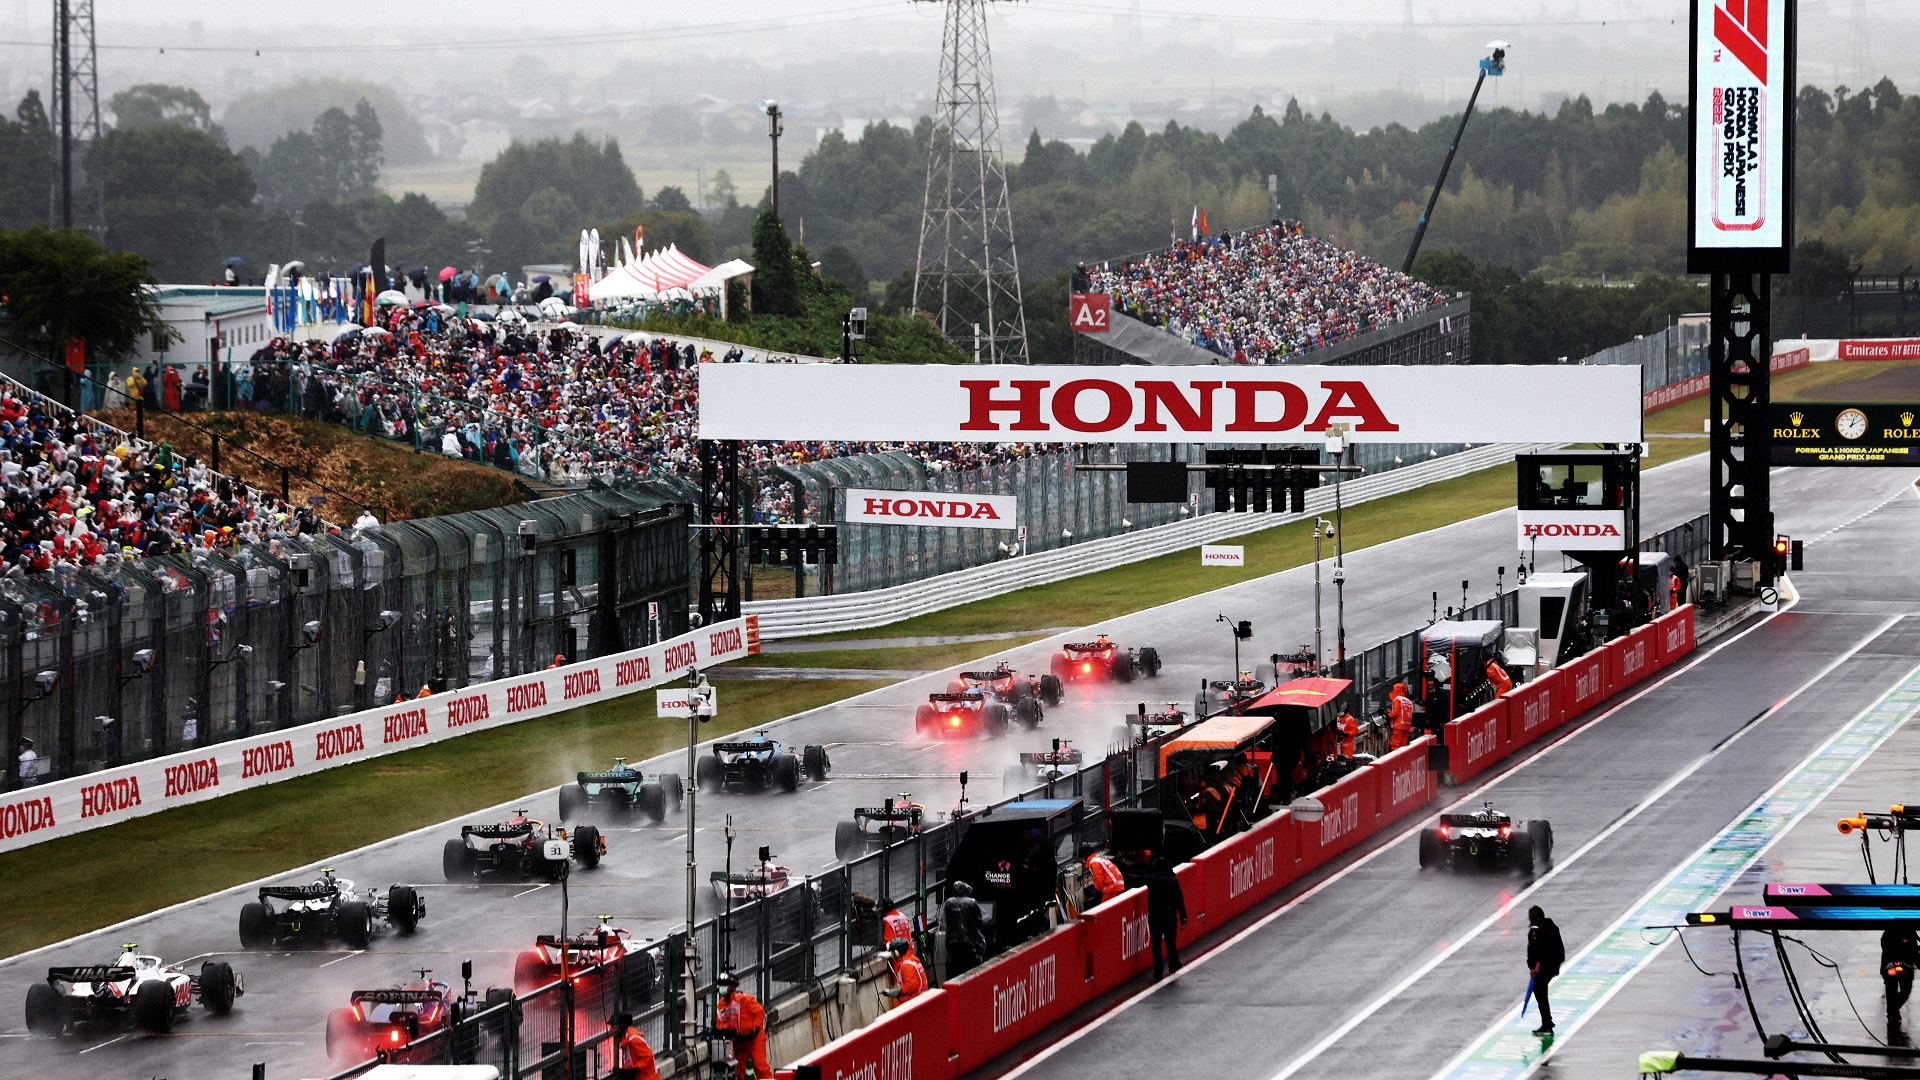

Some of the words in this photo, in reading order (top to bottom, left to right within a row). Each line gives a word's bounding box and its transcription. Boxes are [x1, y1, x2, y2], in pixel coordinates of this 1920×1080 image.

[1712, 87, 1723, 126] 2022
[1724, 87, 1736, 139] GRAND
[1735, 87, 1747, 138] HONDA
[1747, 87, 1759, 161] FORMULA
[1723, 142, 1735, 178] PRIX
[1747, 163, 1758, 171] 1
[1735, 141, 1746, 216] JAPANESE
[1075, 302, 1106, 326] A2
[1846, 344, 1889, 356] Emirates
[1891, 344, 1902, 356] FLY
[959, 379, 1399, 432] HONDA
[1773, 428, 1821, 438] ROLEX
[863, 497, 1000, 520] HONDA
[1523, 523, 1621, 537] HONDA
[664, 641, 697, 673] HONDA
[710, 627, 743, 656] HONDA
[563, 668, 601, 700] HONDA
[615, 656, 651, 687] HONDA
[447, 694, 490, 727] HONDA
[507, 681, 547, 712] HONDA
[315, 723, 365, 761] HONDA
[384, 708, 429, 744] HONDA
[242, 739, 295, 780] HONDA
[164, 757, 220, 798] HONDA
[81, 776, 142, 818] HONDA
[550, 847, 562, 855] 31
[1121, 909, 1150, 961] Emirates
[69, 967, 123, 981] HAAS
[364, 991, 429, 1000] SOFINA
[993, 976, 1027, 1033] Emirates
[1038, 954, 1056, 1008] BETTER
